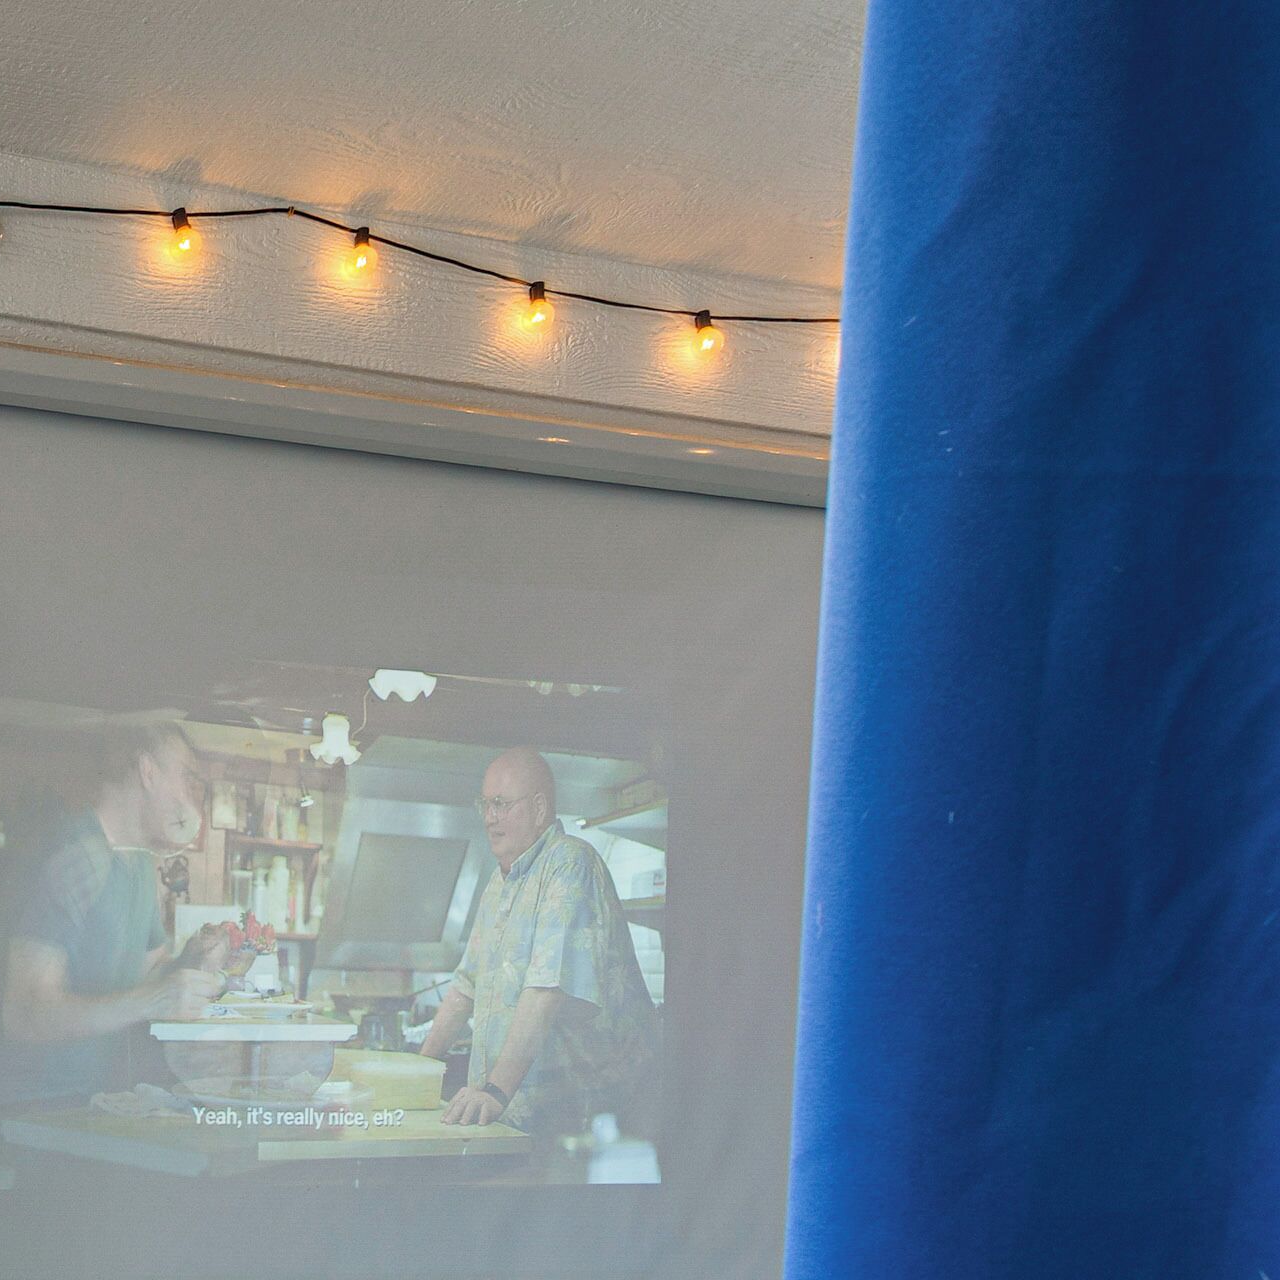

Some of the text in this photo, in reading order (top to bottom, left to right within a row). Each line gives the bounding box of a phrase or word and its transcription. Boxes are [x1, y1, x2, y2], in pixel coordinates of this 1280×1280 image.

[192, 1106, 405, 1130] Yeah, it's really nice, eh?
